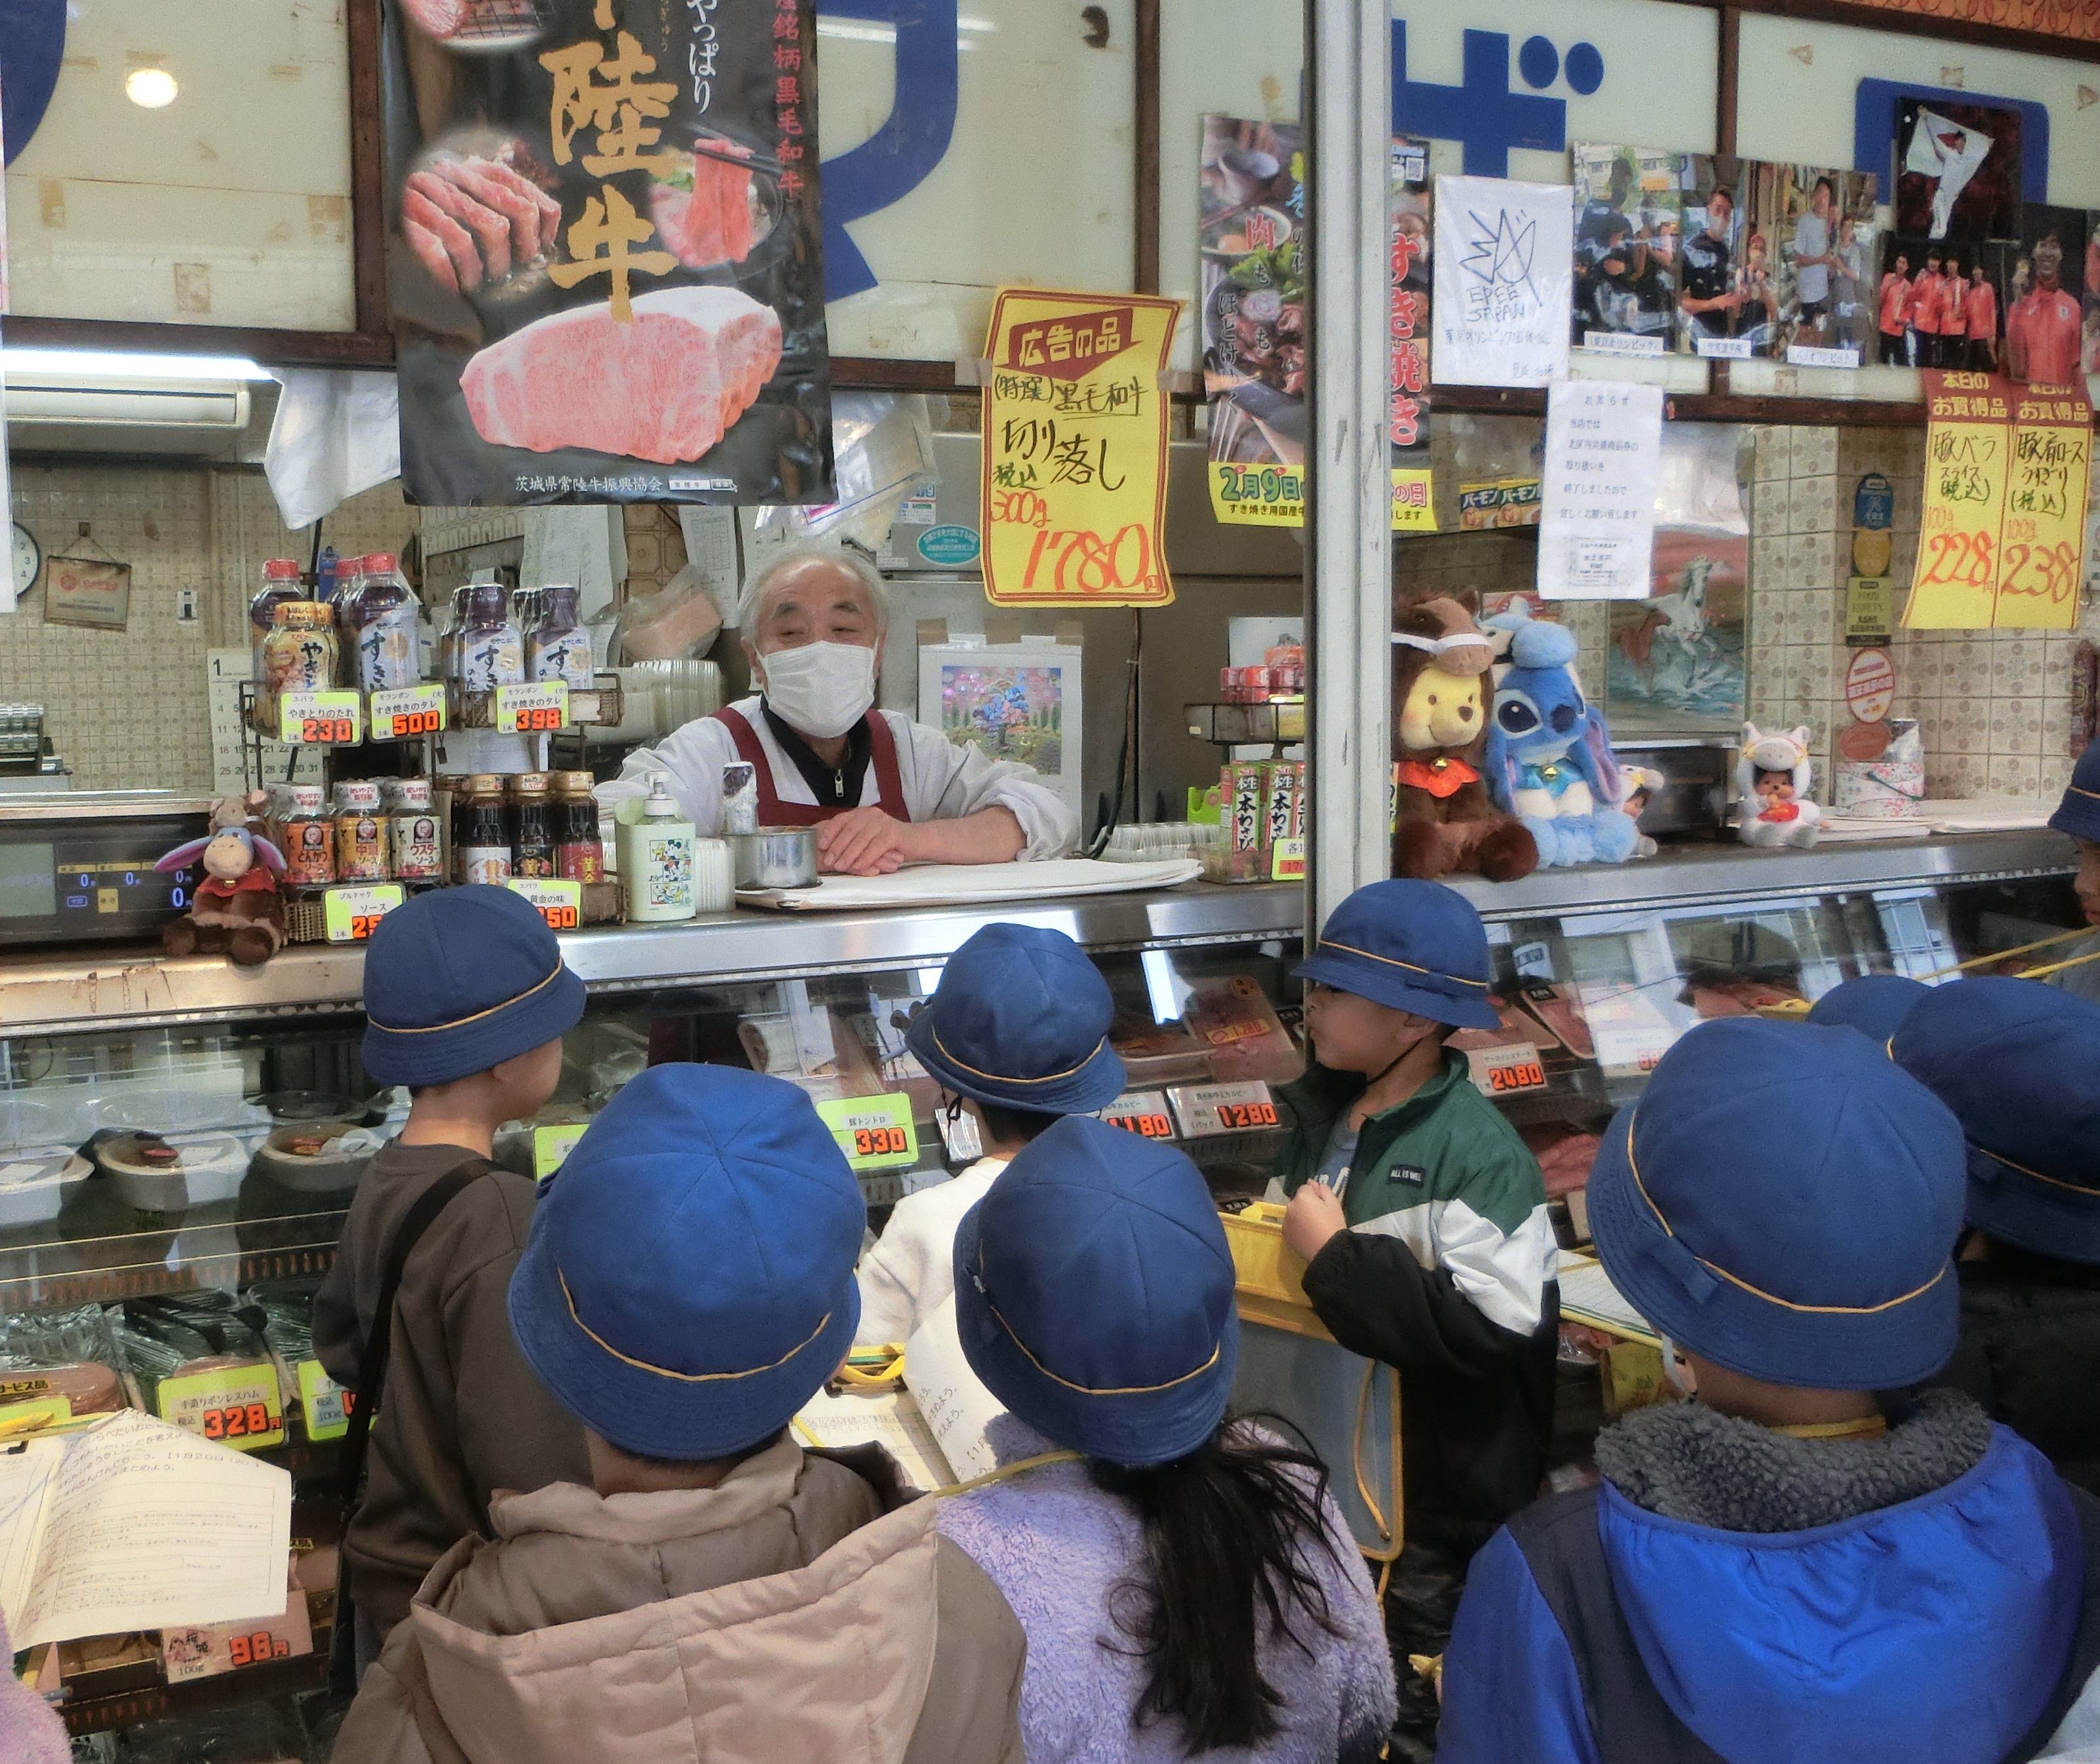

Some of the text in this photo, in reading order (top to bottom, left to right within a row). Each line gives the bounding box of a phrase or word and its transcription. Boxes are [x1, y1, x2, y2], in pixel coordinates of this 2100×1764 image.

[687, 0, 720, 115] やっぱり
[539, 0, 679, 324] 陸牛
[1019, 316, 1120, 367] 広告の品
[1942, 372, 1990, 390] 本日の
[1585, 395, 1629, 406] お知らせ
[1933, 396, 2009, 418] お買得品
[2018, 400, 2090, 422] お買得品
[1001, 417, 1125, 491] 切り落し
[515, 475, 663, 493] 茨城県常陸牛振興協会
[992, 462, 1045, 491] 税込
[1220, 466, 1300, 503] 2月9日
[1391, 510, 1422, 521] します
[213, 658, 221, 676] 1
[378, 691, 410, 700] モランボン
[509, 687, 537, 696] モランボン
[288, 708, 355, 719] やきとりのたれ
[375, 701, 437, 714] すき焼きのタレ
[501, 697, 561, 710] すき焼きのタレ
[393, 710, 439, 736] 500
[516, 708, 562, 731] 398
[303, 719, 353, 743] 230
[1236, 793, 1258, 851] 本わさび
[298, 851, 328, 863] とんかつ
[172, 887, 184, 908] 0
[339, 891, 372, 900] ブルドック
[530, 894, 565, 904] 黄金の味
[360, 903, 387, 914] ソース
[1488, 1063, 1545, 1091] 2480
[848, 1116, 885, 1126] 豚トントロ
[1217, 1102, 1279, 1128] 1280
[854, 1127, 908, 1155] 330
